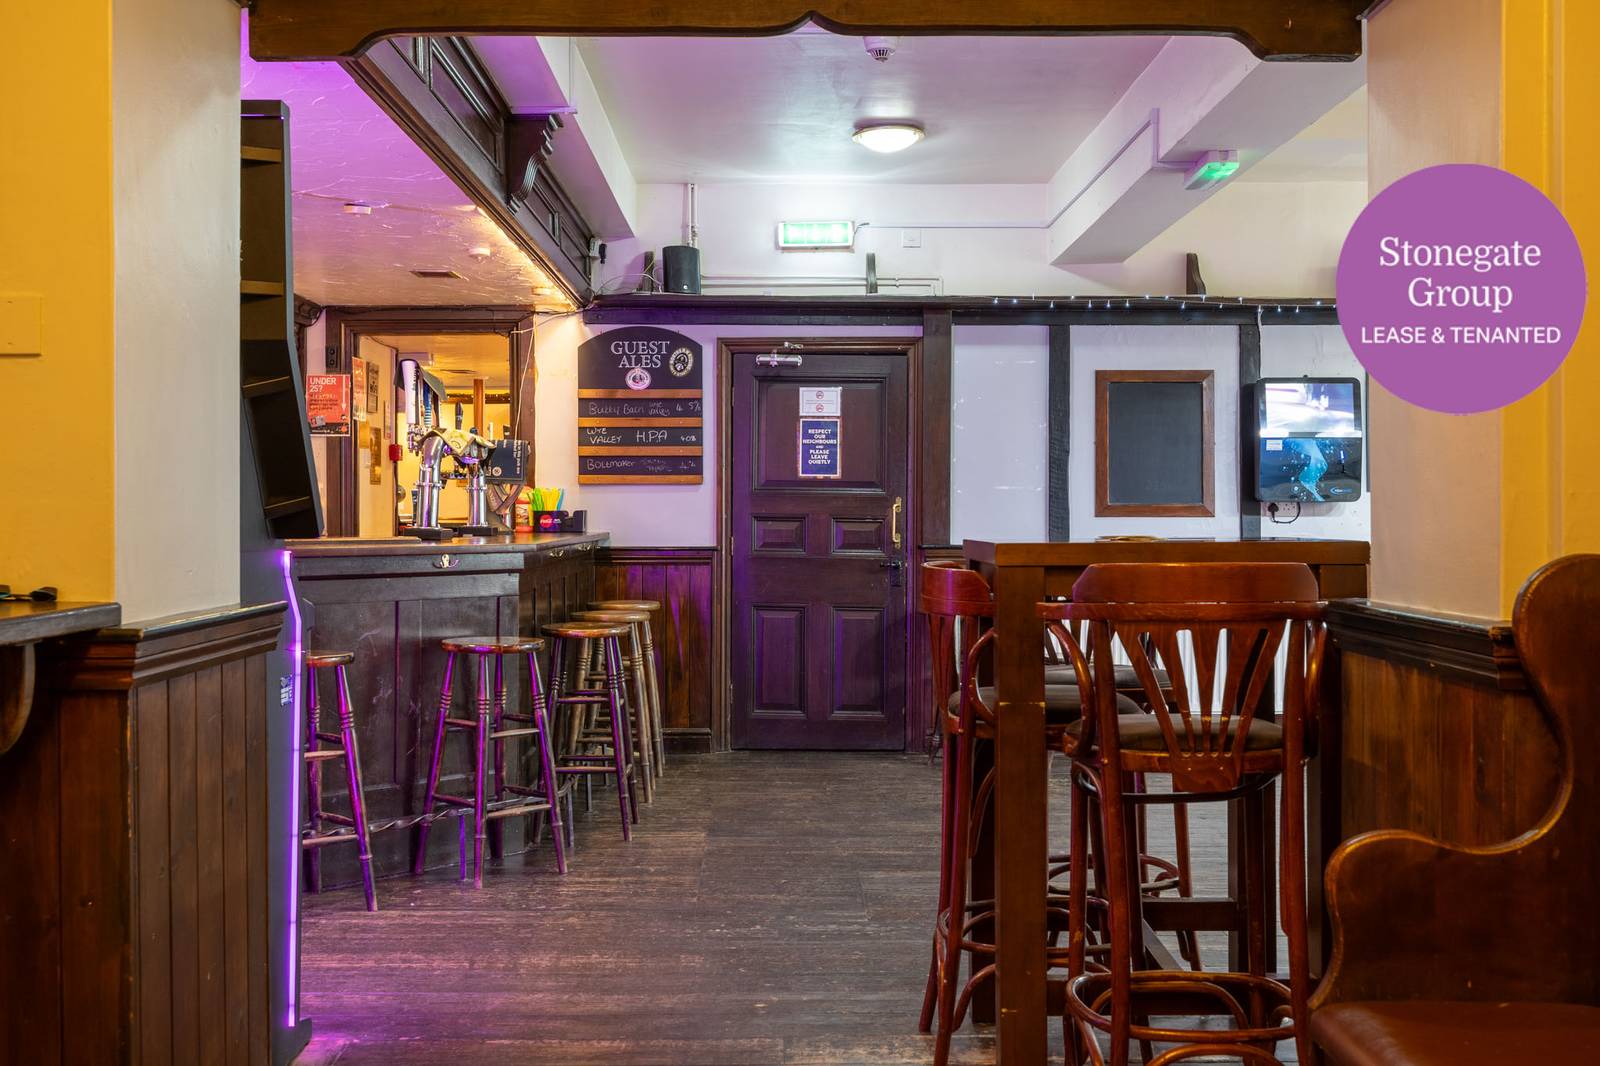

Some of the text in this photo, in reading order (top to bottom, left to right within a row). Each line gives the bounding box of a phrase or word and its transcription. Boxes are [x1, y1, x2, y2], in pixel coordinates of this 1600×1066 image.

[610, 341, 670, 355] GUEST
[618, 355, 661, 368] ALES
[309, 377, 336, 385] UNDER
[309, 384, 323, 392] 25?
